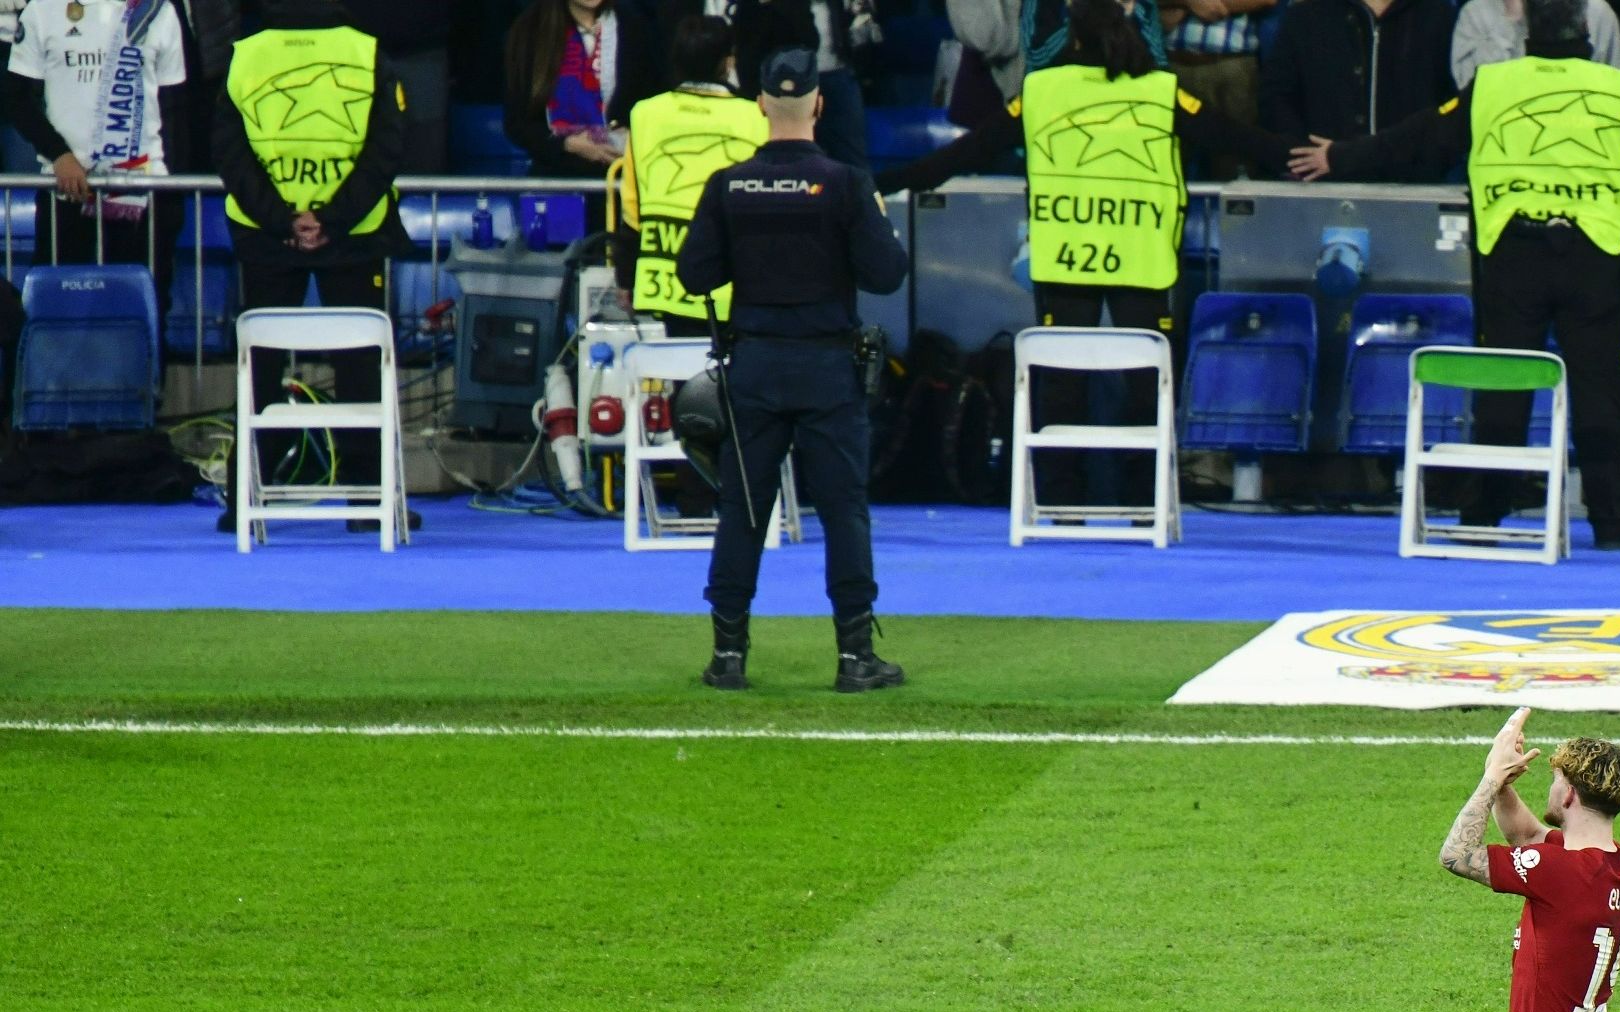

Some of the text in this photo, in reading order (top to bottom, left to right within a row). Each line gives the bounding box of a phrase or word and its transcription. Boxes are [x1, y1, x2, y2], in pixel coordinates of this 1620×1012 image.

[106, 46, 142, 132] MADRID
[728, 179, 810, 193] POLICIA
[1055, 242, 1121, 274] 426
